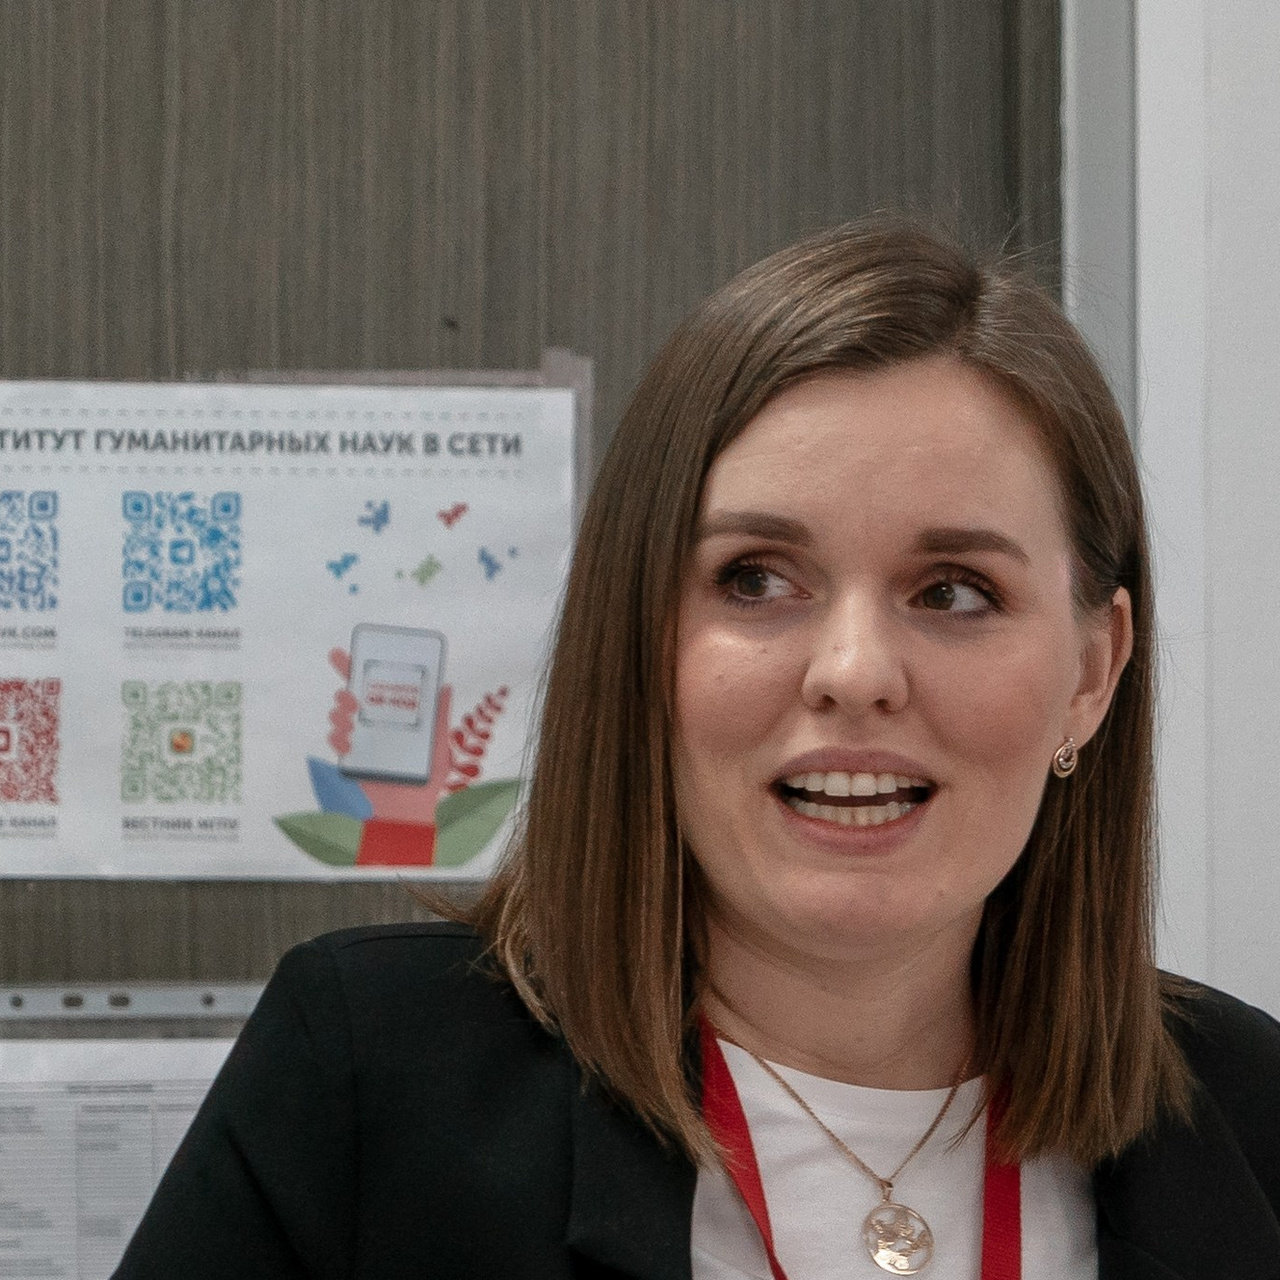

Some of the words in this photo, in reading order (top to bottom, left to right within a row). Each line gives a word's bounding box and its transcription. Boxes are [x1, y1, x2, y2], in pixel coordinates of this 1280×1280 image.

[94, 428, 330, 455] ГУМАНИТАРНЫХ
[338, 430, 414, 456] НАУК
[421, 432, 441, 457] В
[446, 432, 522, 458] СЕТИ
